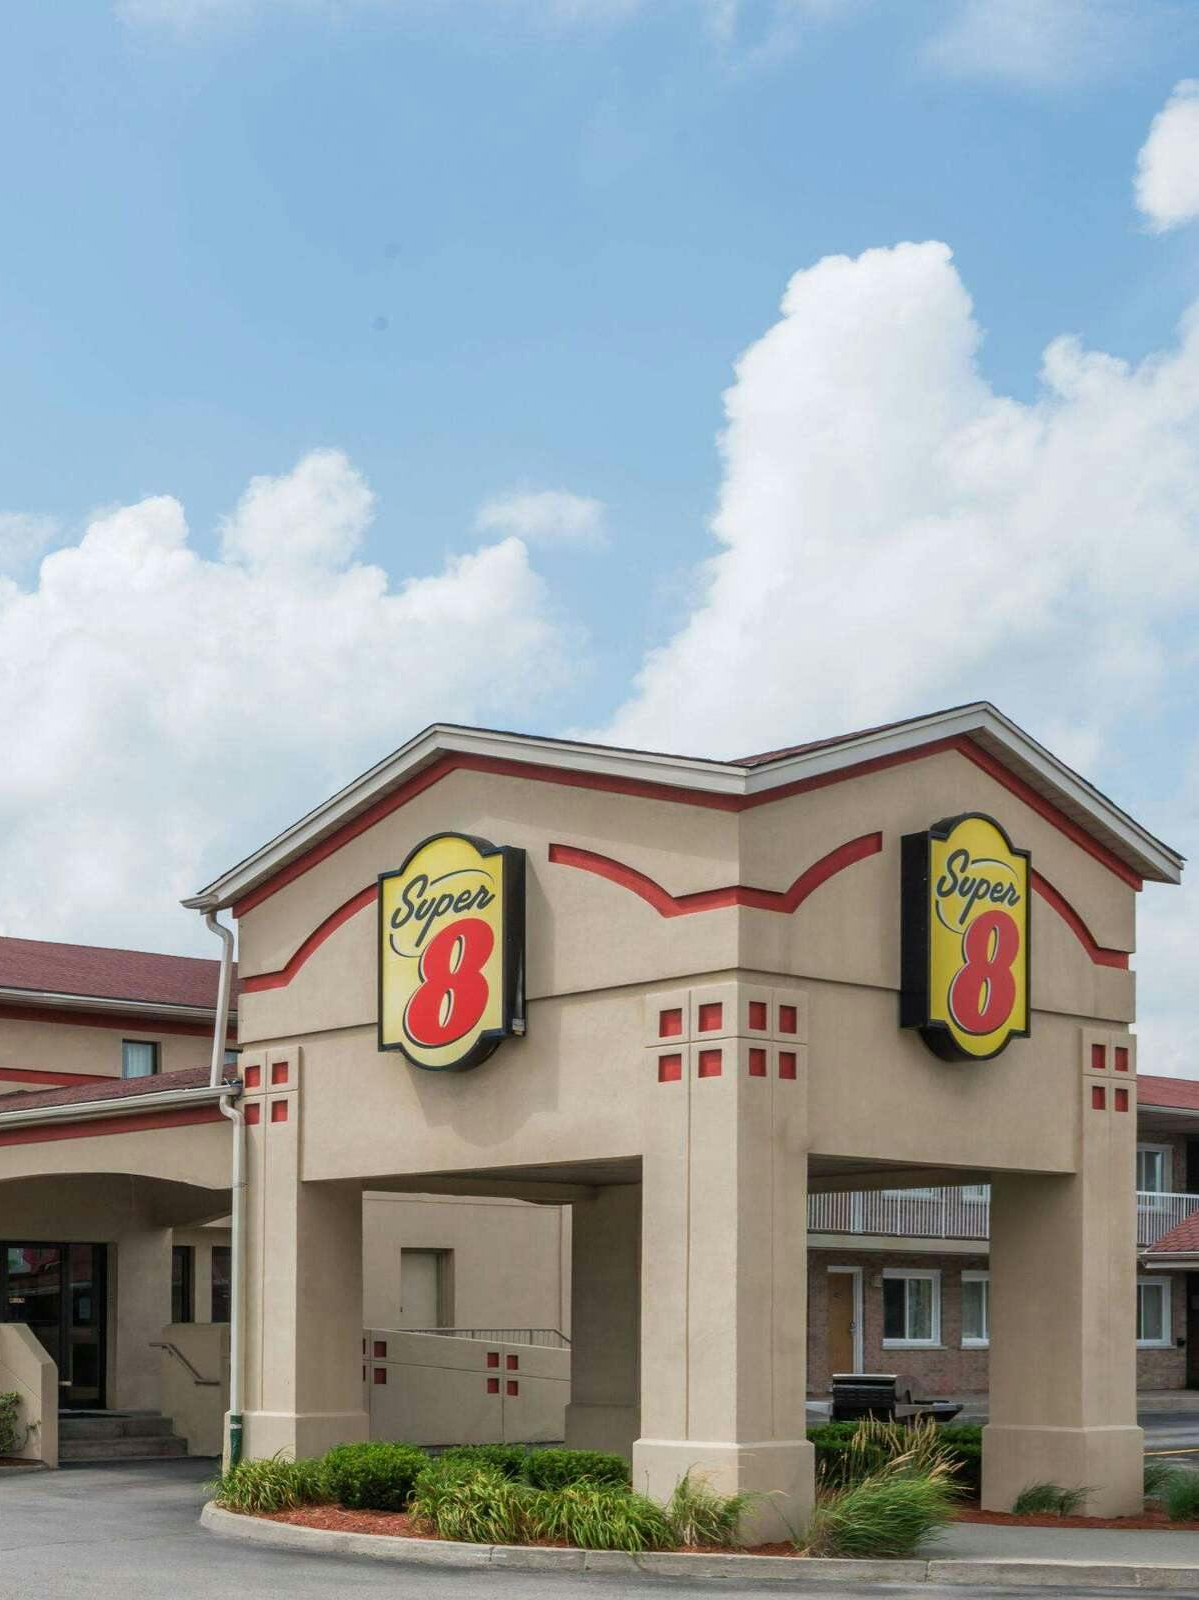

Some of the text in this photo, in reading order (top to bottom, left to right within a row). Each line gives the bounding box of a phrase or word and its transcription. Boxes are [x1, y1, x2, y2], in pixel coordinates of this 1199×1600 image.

[391, 874, 496, 947] Super
[936, 849, 1021, 925] Super
[402, 918, 495, 1049] 8
[947, 910, 1020, 1036] 8
